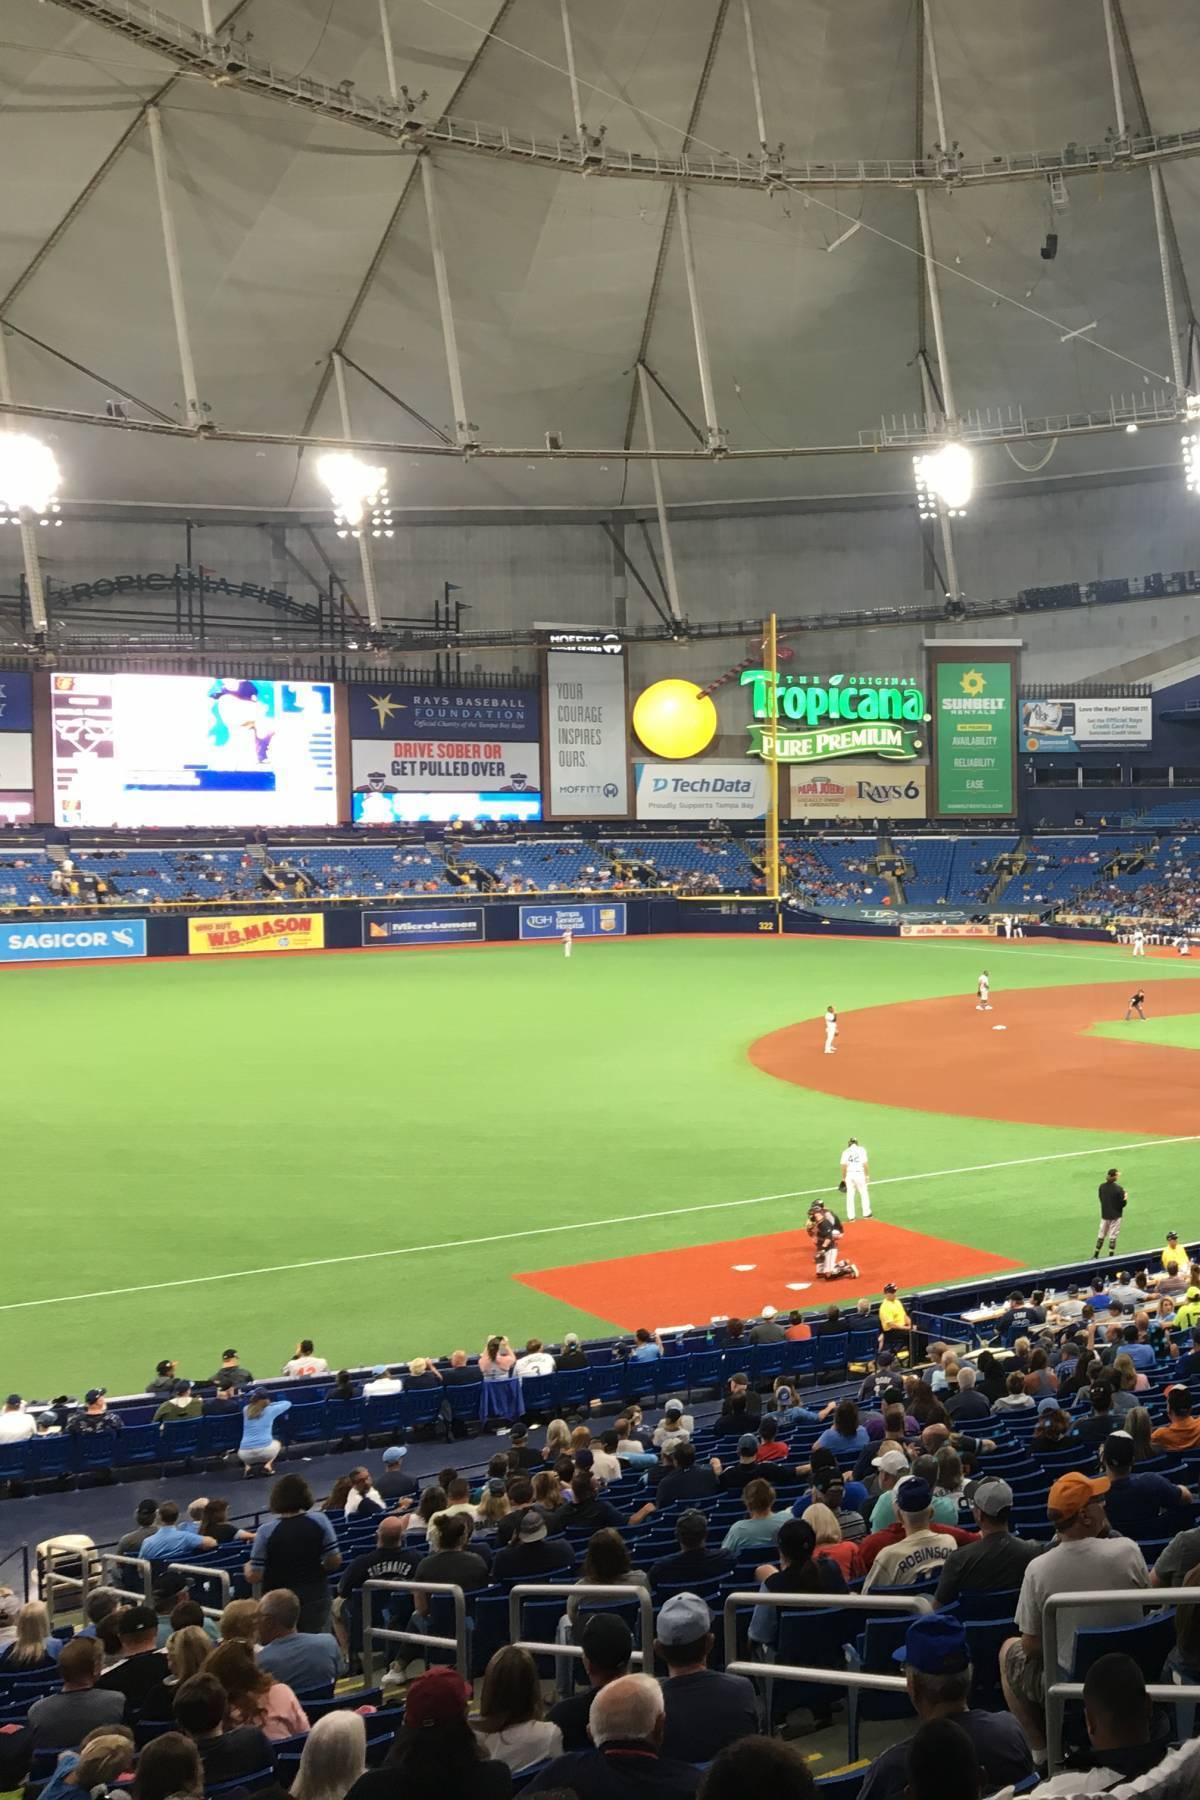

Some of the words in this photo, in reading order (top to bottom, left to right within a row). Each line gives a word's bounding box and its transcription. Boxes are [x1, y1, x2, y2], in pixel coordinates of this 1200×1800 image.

[786, 676, 821, 685] THE
[849, 677, 917, 686] ORIGINAL
[556, 683, 584, 700] YOUR
[740, 670, 924, 726] Tropicana
[413, 695, 450, 706] RAYS
[456, 697, 526, 708] BASEBALL
[942, 698, 1006, 710] SUNBELT
[414, 708, 526, 720] FOUNDATION
[557, 705, 603, 723] COURAGE
[414, 720, 437, 728] Official
[438, 721, 460, 729] Charity
[557, 728, 602, 746] INSPIRES
[762, 735, 813, 756] PURE
[816, 728, 902, 753] PREMIUM
[952, 736, 997, 746] AVAILABILITY
[393, 742, 434, 759] DRIVE
[436, 743, 481, 759] SOBER
[484, 744, 502, 759] OR
[558, 750, 588, 767] OURS.
[954, 758, 996, 768] RELIABILITY
[391, 760, 417, 777] GET
[420, 761, 470, 777] PULLED
[471, 761, 506, 777] OVER
[559, 785, 601, 794] MOFFITT
[671, 778, 710, 792] Tech
[712, 778, 752, 792] Data
[904, 780, 920, 799] 6
[966, 779, 984, 789] EASE
[648, 801, 676, 810] Proudly
[679, 801, 713, 810] Supports
[715, 802, 739, 810] Tampa
[741, 802, 754, 810] Bay
[391, 921, 477, 931] MicroLumen
[758, 921, 774, 930] 322
[8, 932, 109, 950] SAGICOR
[898, 1545, 953, 1573] ROBINSO
